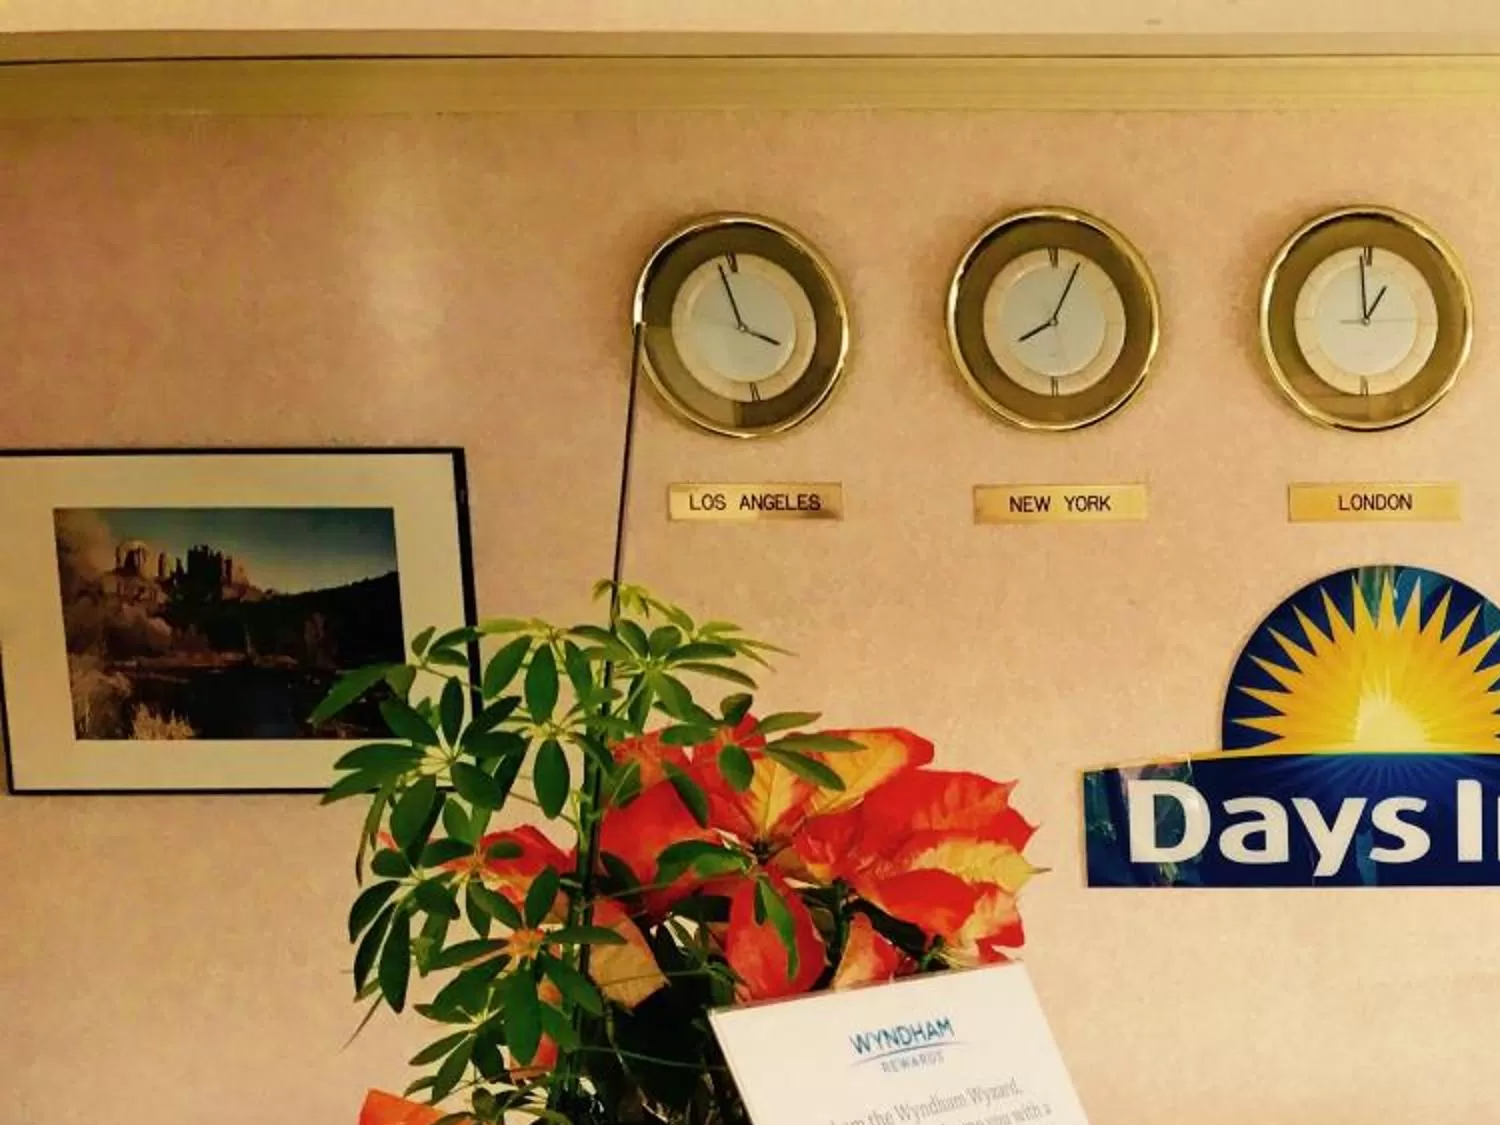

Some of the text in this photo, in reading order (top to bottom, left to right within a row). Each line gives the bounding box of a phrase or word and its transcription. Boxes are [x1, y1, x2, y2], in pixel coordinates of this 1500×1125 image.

[689, 494, 822, 511] LOS ANGELES
[1009, 495, 1112, 513] NEW YORK
[1337, 494, 1413, 512] LONDON
[1128, 778, 1432, 877] Days
[849, 1017, 955, 1054] WYNDHAM
[881, 1051, 945, 1072] REWARDS
[893, 1092, 966, 1125] Wyndham
[1011, 1103, 1042, 1122] with
